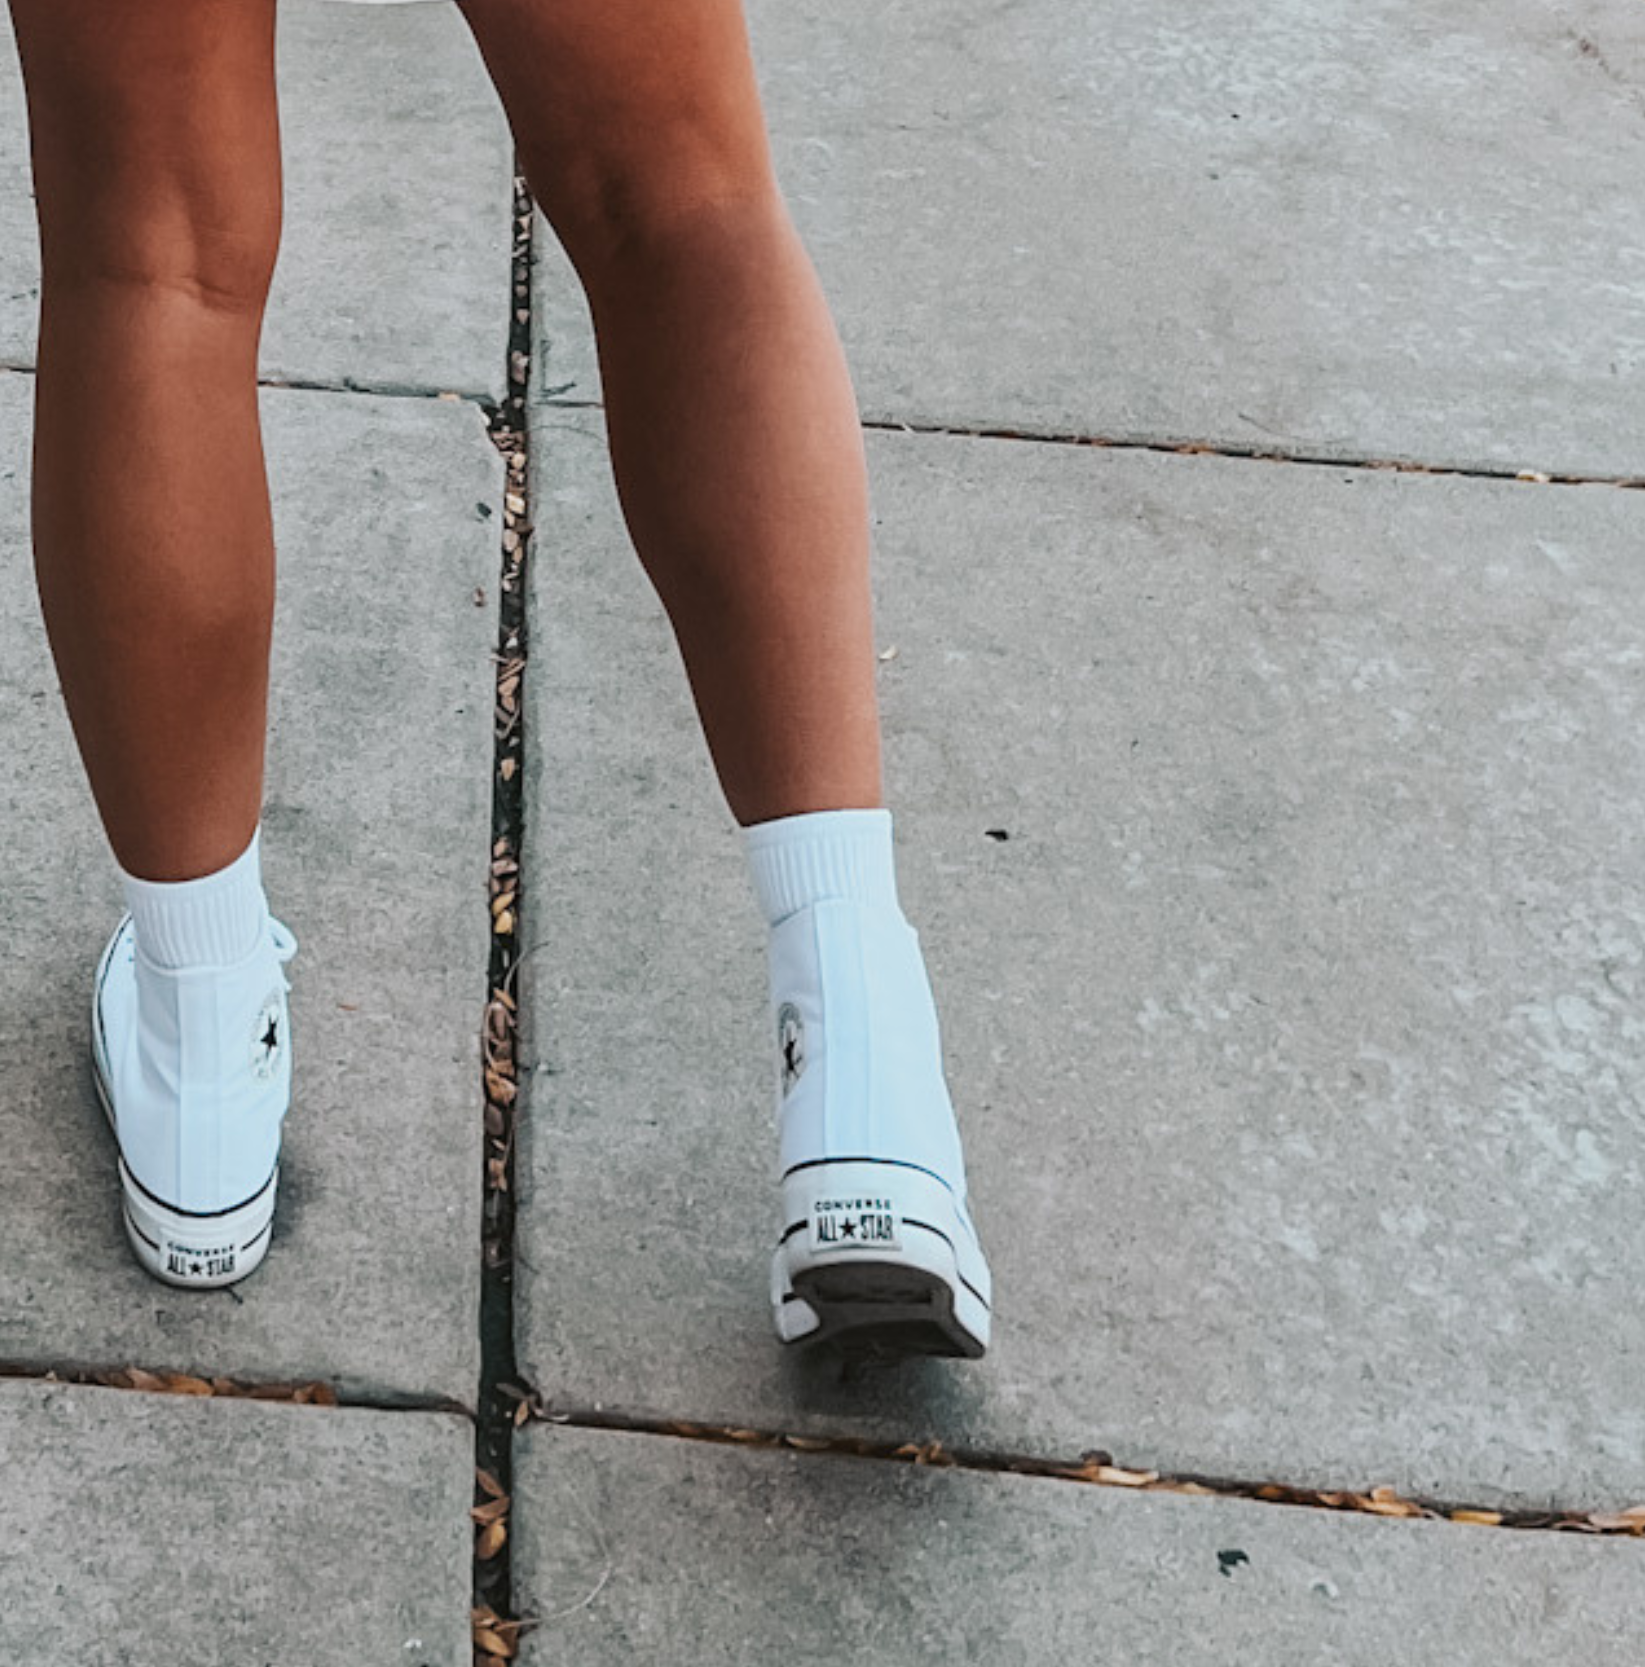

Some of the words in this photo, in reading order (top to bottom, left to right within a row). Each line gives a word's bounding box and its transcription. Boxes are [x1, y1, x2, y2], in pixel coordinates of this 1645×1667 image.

[814, 1198, 891, 1212] CONVERSE
[817, 1214, 838, 1242] ALL
[860, 1214, 893, 1240] STAR
